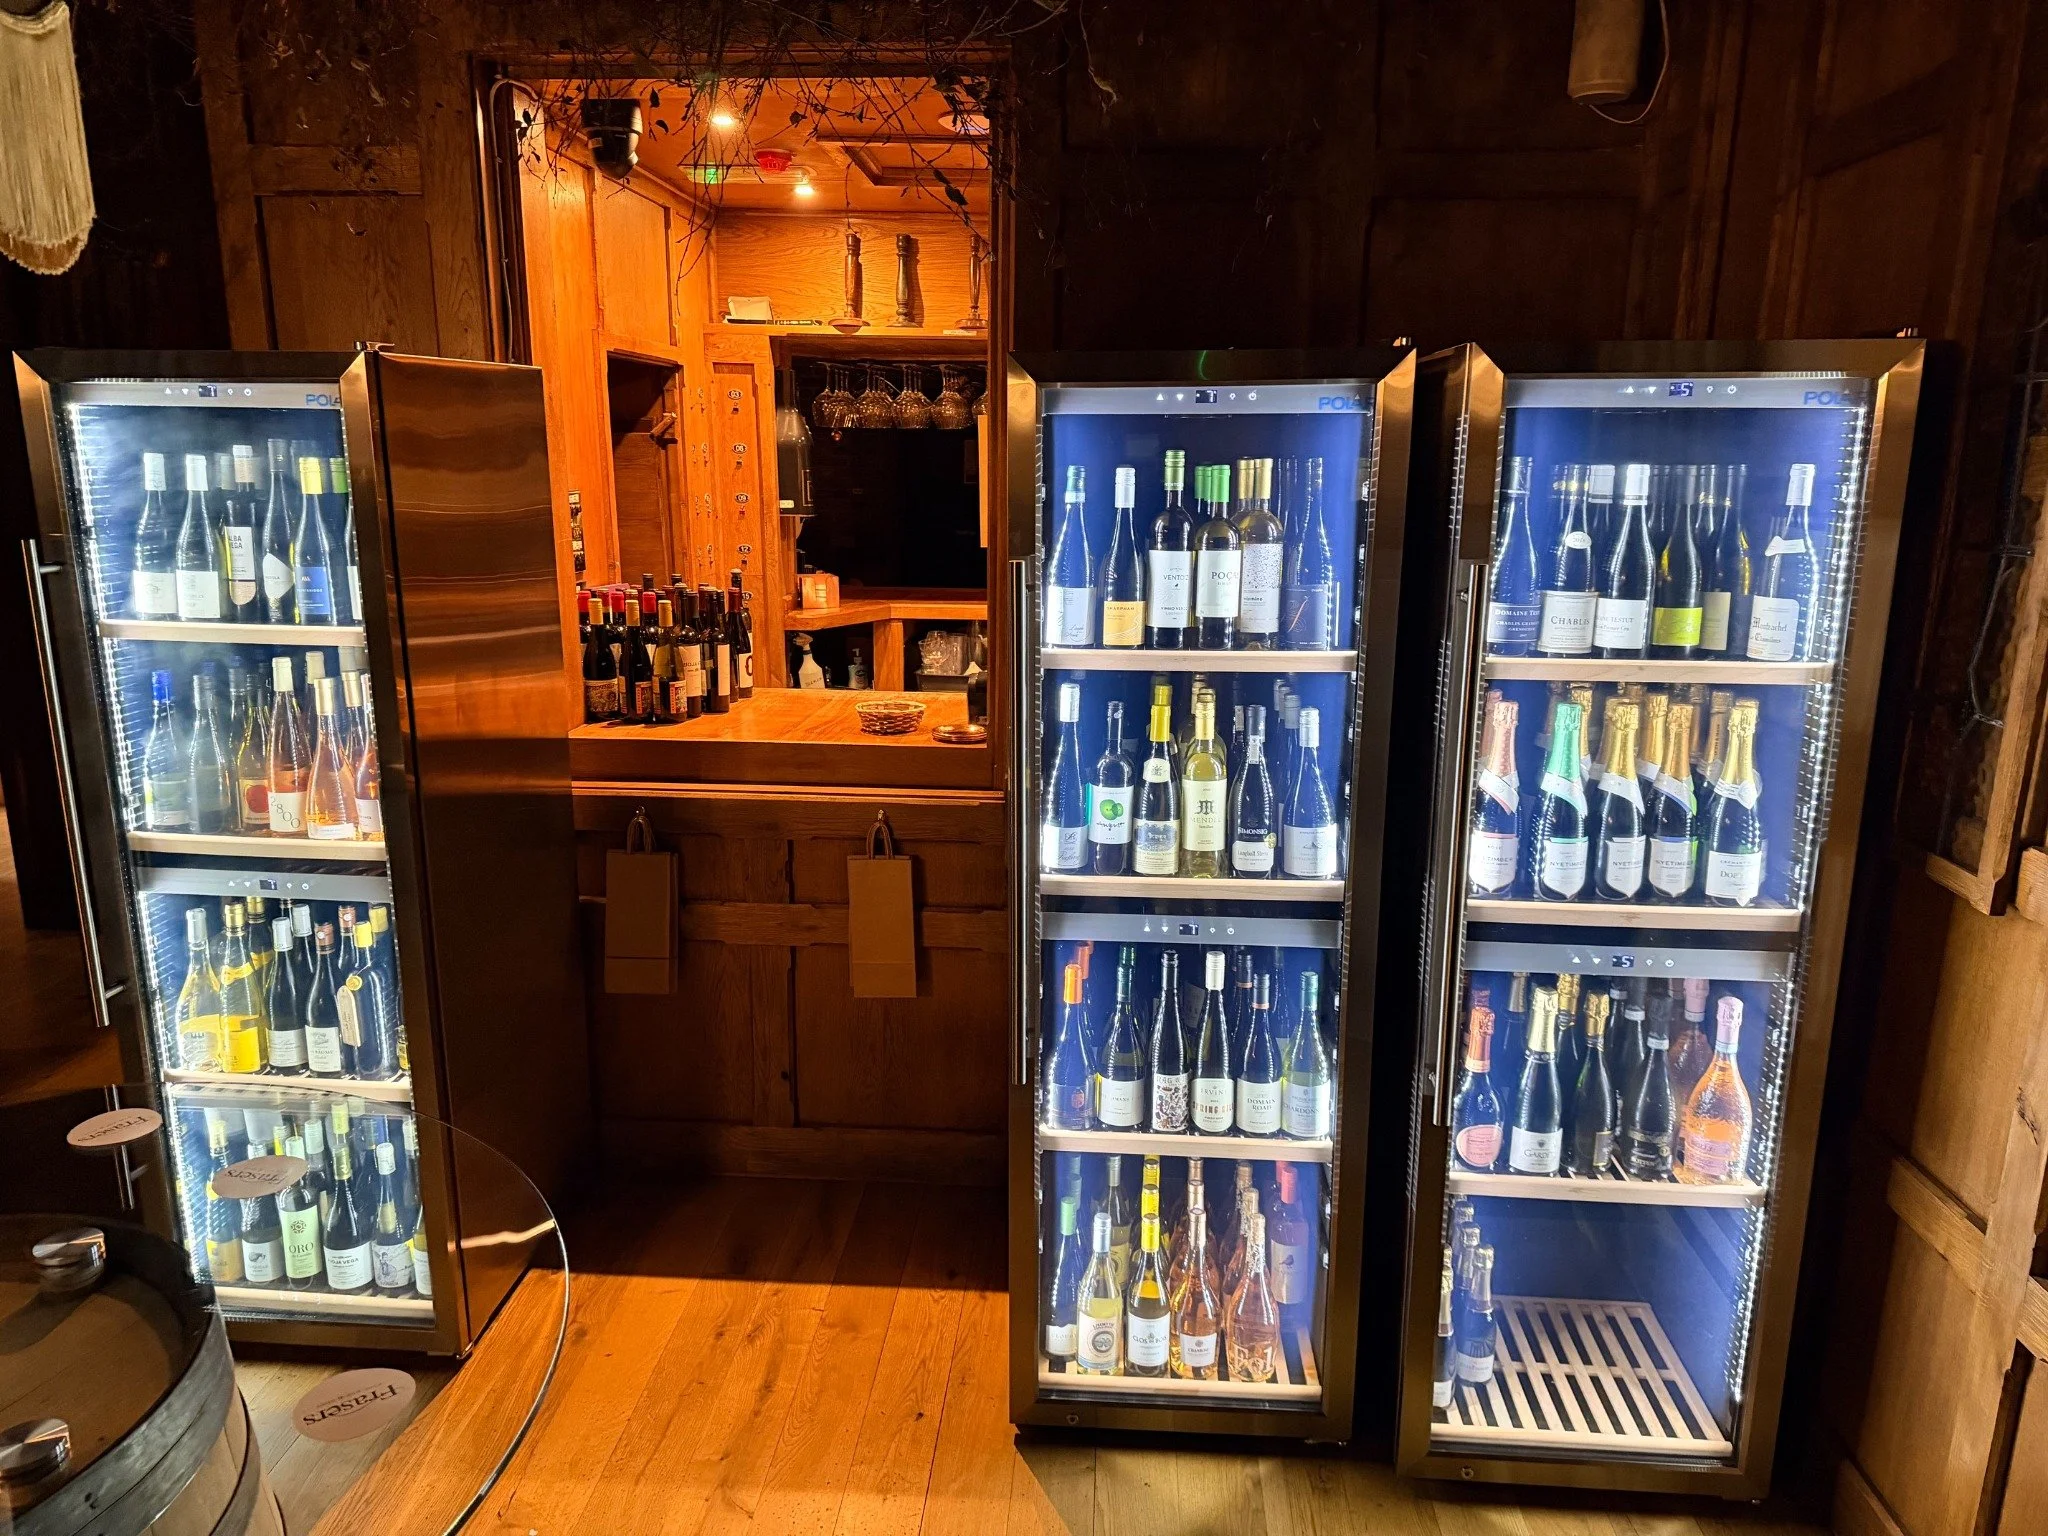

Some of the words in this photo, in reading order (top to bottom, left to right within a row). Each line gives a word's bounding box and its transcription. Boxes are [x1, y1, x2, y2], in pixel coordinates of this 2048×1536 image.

[1550, 615, 1590, 626] CHABLIS
[1237, 826, 1268, 835] SIMONSIG
[288, 1242, 314, 1254] ORO
[302, 1385, 398, 1426] Frasers
